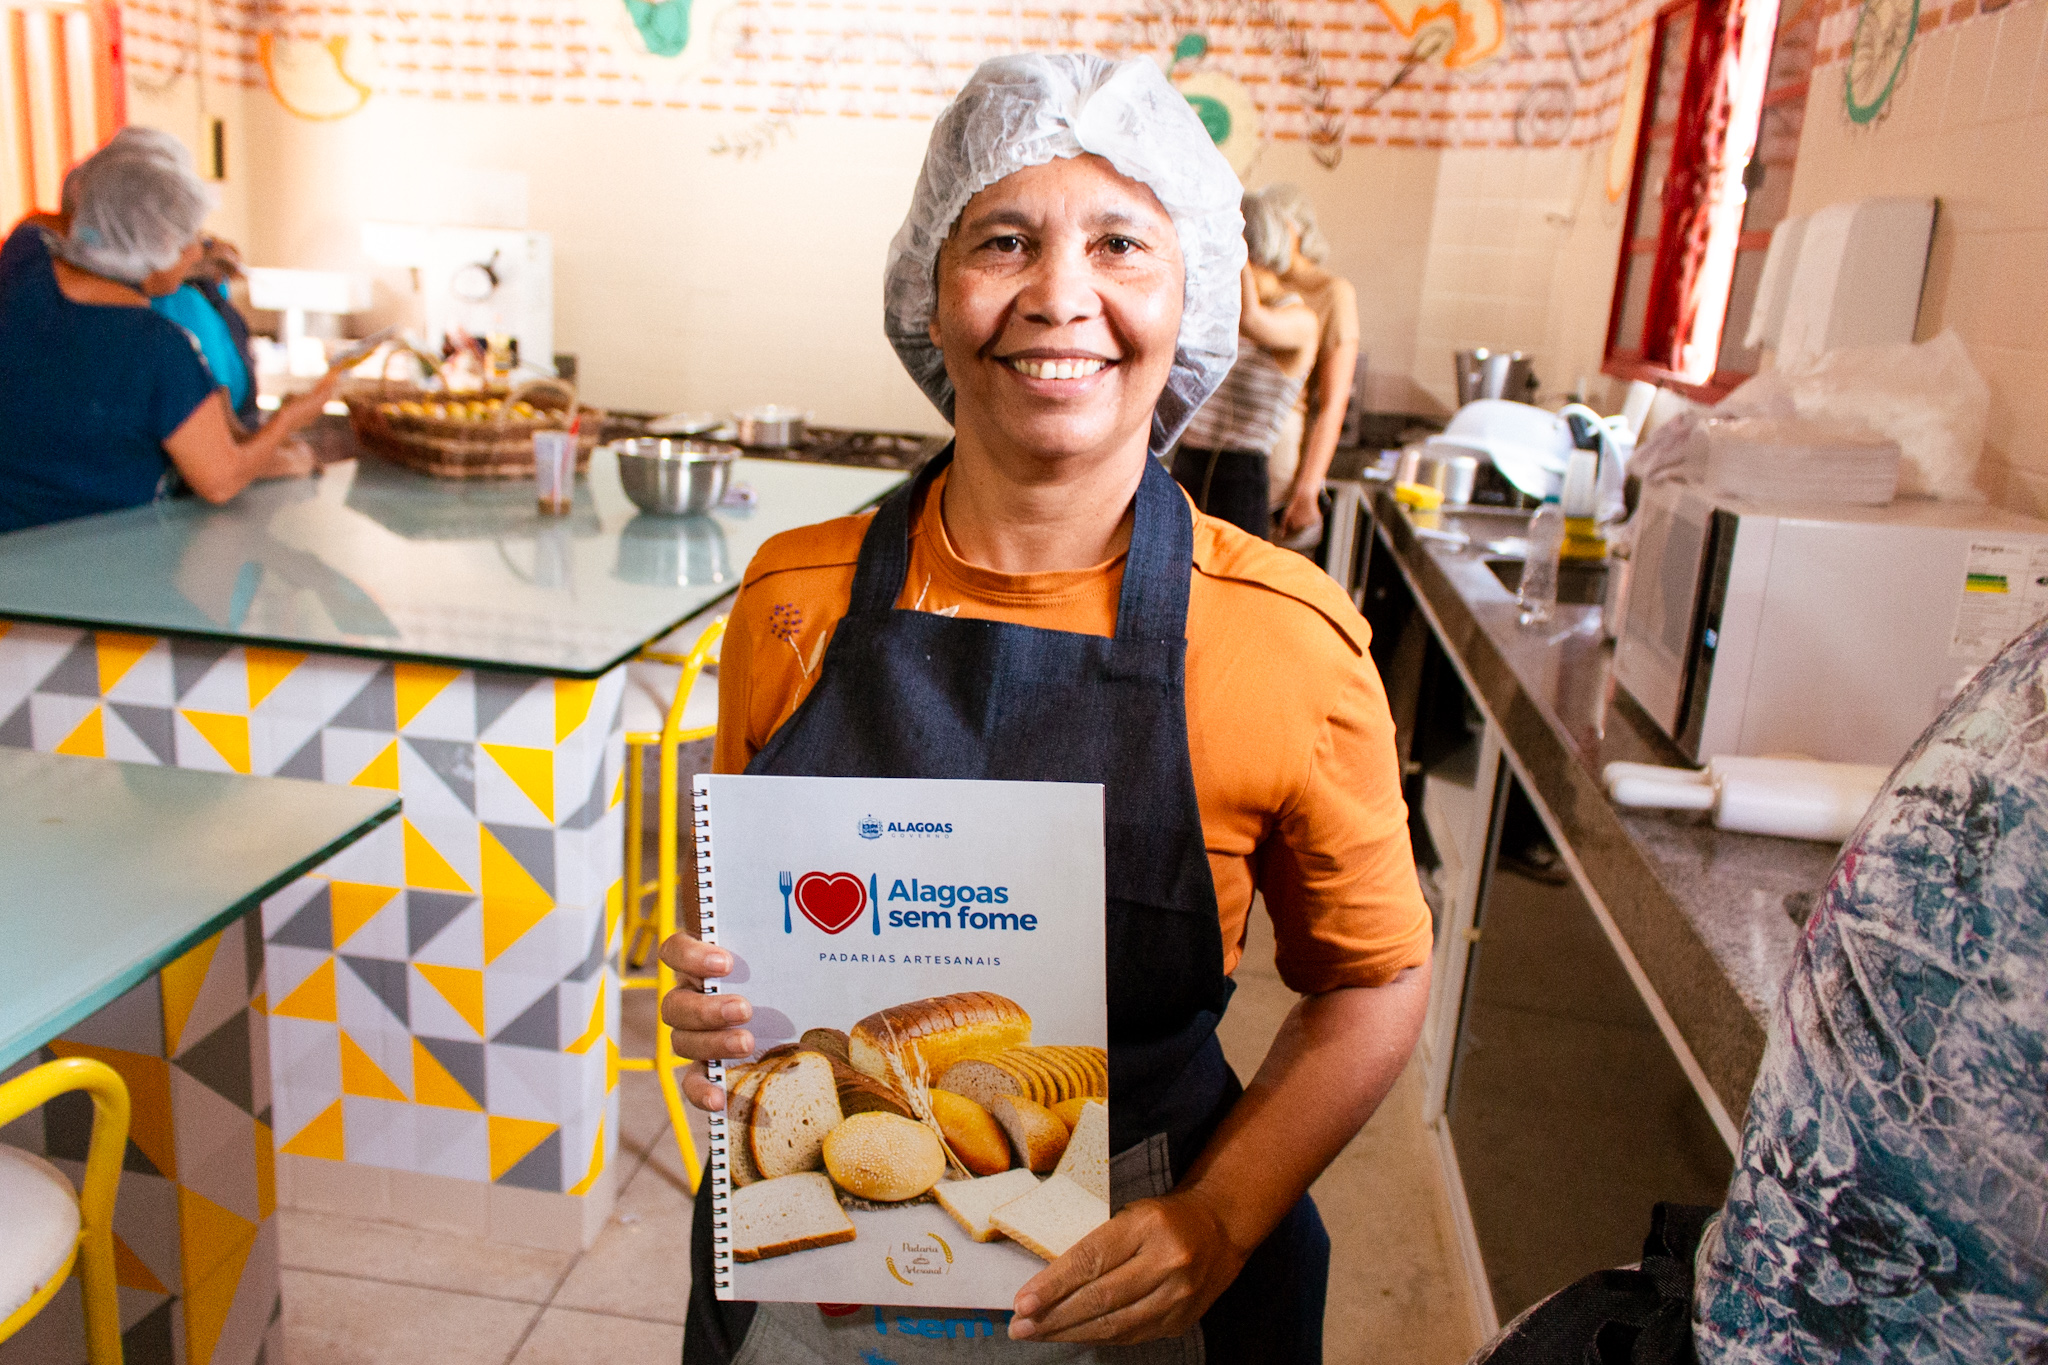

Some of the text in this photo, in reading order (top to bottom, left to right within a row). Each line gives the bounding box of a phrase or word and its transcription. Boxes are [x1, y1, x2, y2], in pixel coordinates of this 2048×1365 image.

[887, 822, 953, 833] ALAGOAS
[887, 878, 1009, 908] Alagoas
[888, 905, 1038, 931] sem fome
[819, 952, 1001, 966] PADARIAS ARTESANAIS
[902, 1242, 939, 1253] Padaria
[904, 1264, 942, 1275] Artesanal
[897, 1315, 994, 1339] sem
